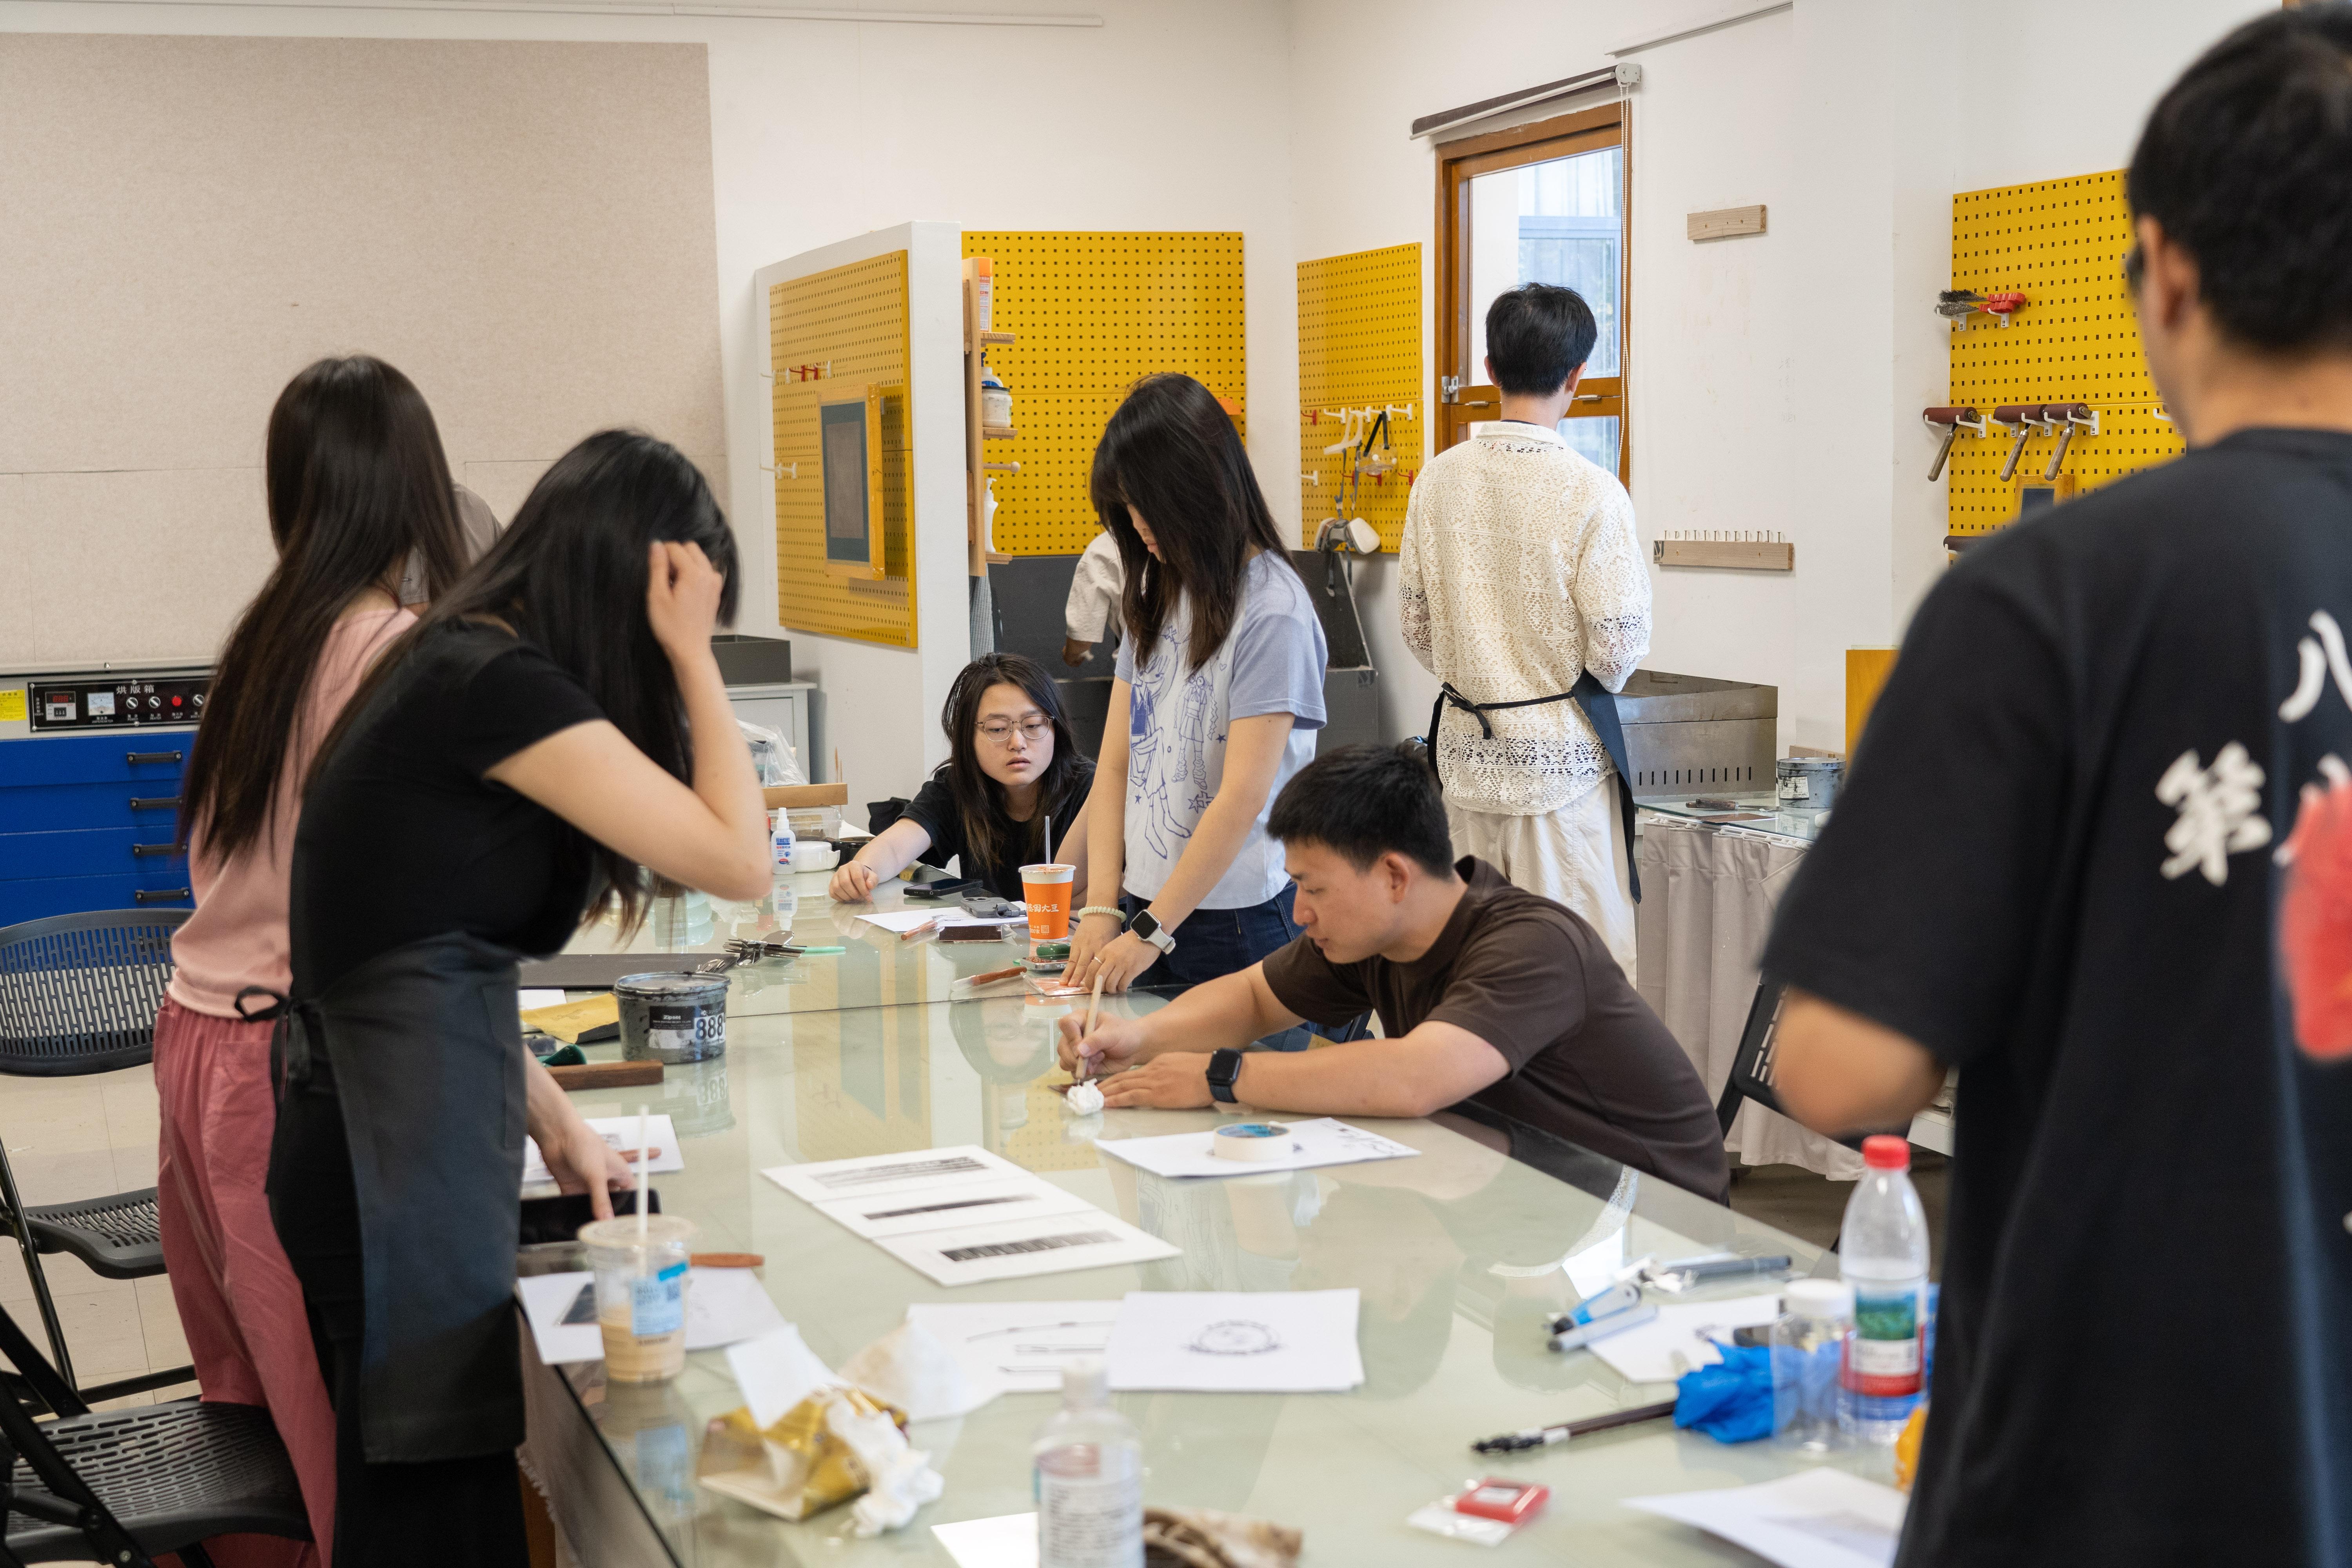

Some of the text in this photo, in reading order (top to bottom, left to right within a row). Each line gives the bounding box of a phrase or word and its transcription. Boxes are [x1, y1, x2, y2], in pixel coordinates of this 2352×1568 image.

[2278, 609, 2352, 723] 八
[116, 684, 154, 694] 烘版箱
[2155, 740, 2272, 887] 第
[1026, 903, 1059, 913] 基因大豆
[695, 1014, 723, 1040] 888
